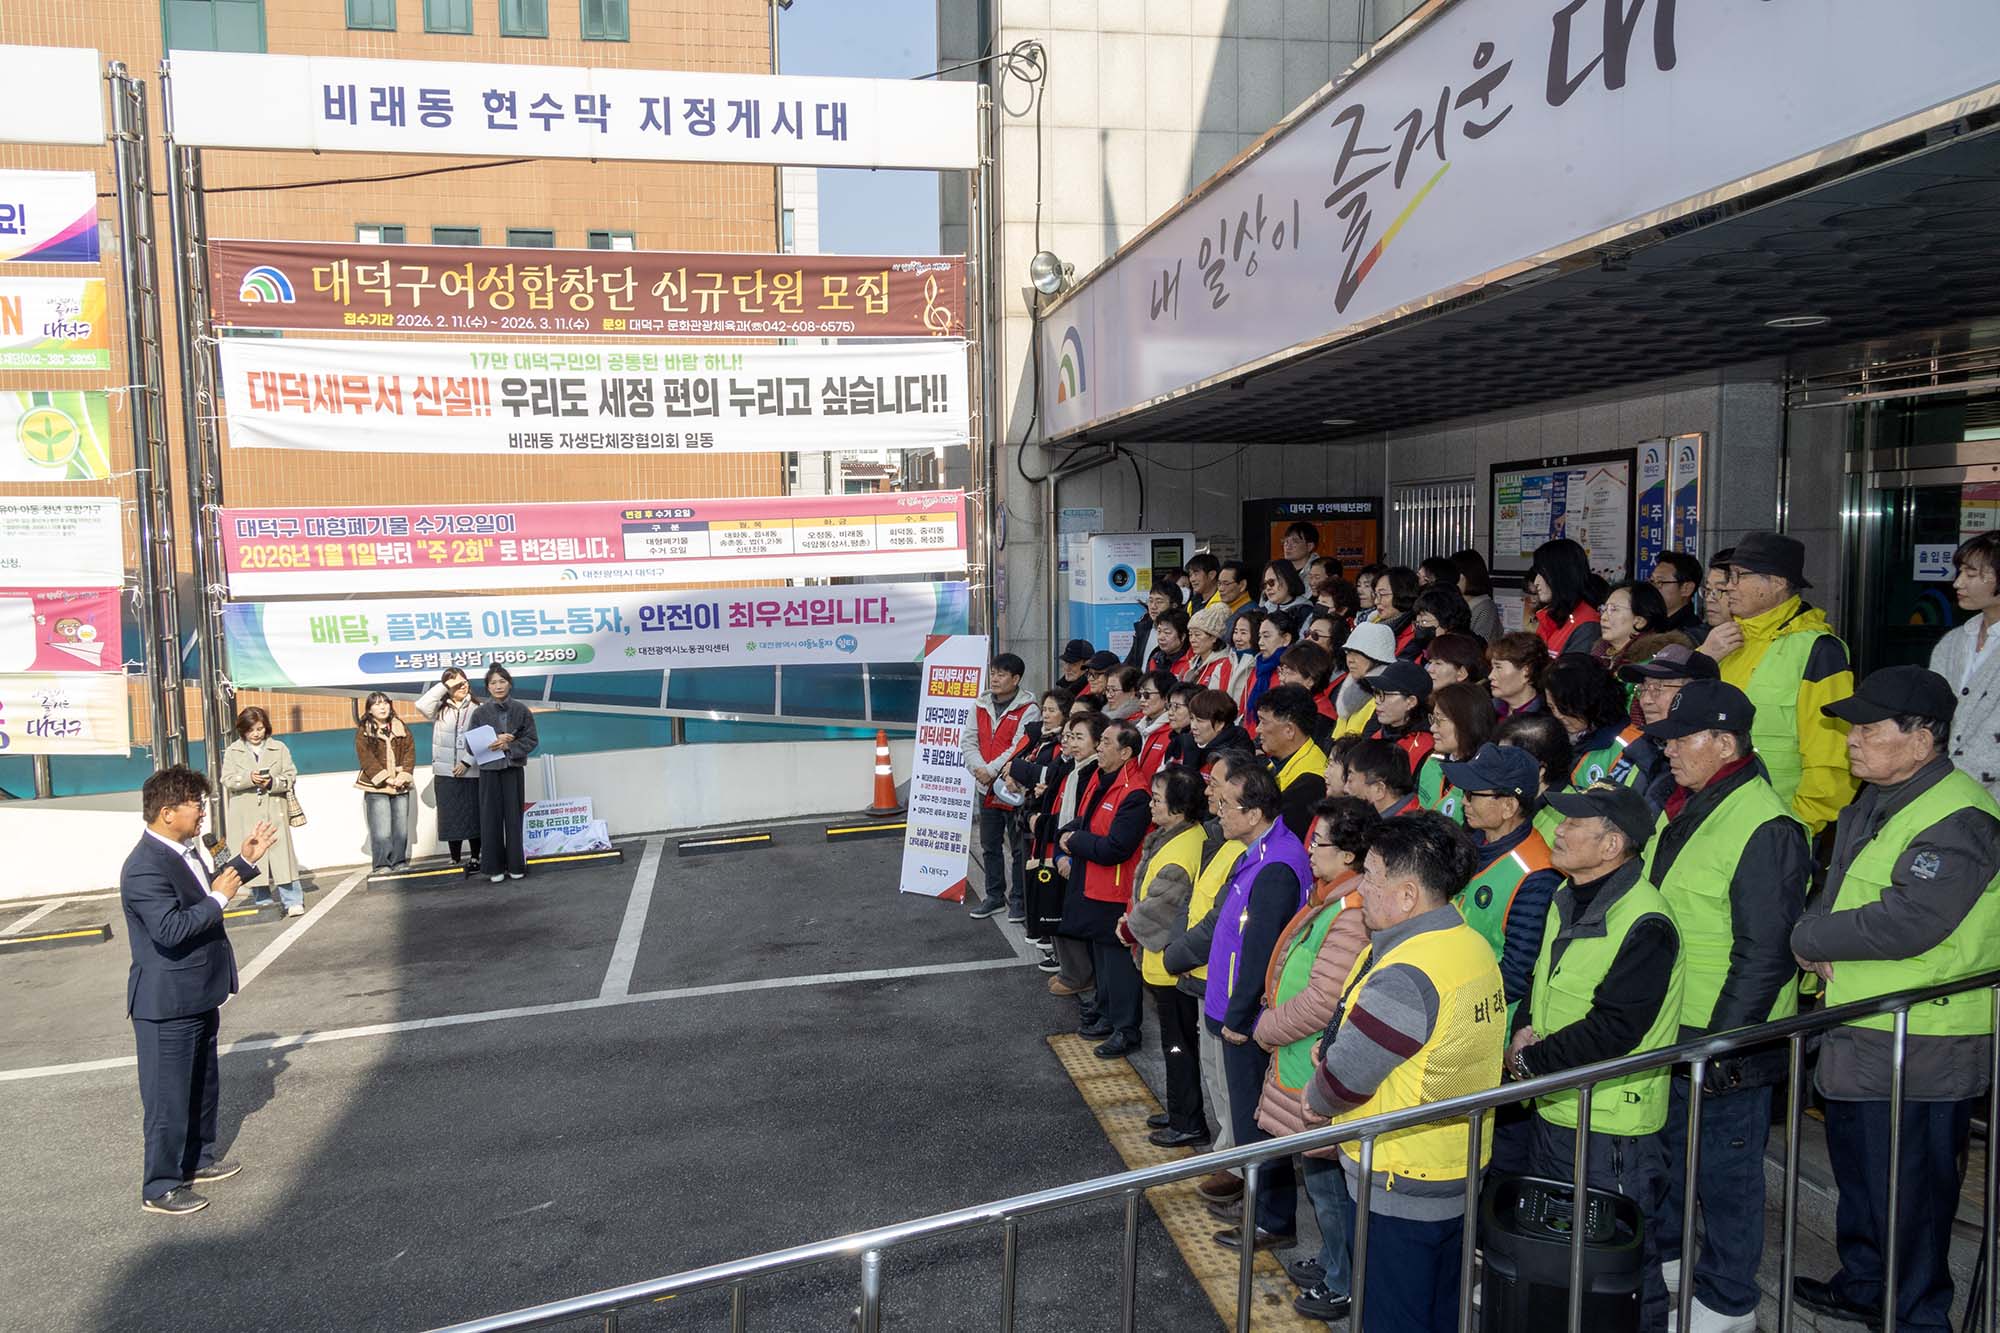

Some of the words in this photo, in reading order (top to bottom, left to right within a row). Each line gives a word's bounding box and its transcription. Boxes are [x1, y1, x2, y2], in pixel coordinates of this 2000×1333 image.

[322, 83, 455, 128] 비래동
[482, 87, 611, 133] 현수막
[638, 95, 849, 141] 지정게시대
[1151, 259, 1182, 322] 내
[1198, 192, 1300, 311] 일상이
[1325, 40, 1513, 314] 즐거운
[312, 258, 639, 312] 대덕구여성합창단
[651, 266, 804, 315] 신규단원
[817, 271, 890, 315] 모집
[343, 312, 393, 327] 접수기간
[396, 314, 434, 327] 2026.
[436, 315, 449, 328] 2.
[451, 314, 488, 330] 11.(수)
[501, 315, 537, 329] 2026.
[539, 317, 552, 330] 3.
[554, 316, 590, 331] 11.(수)
[602, 318, 626, 332] 문의
[629, 319, 665, 332] 대덕구
[469, 351, 509, 370] 17만
[513, 352, 602, 371] 대덕구민의
[607, 352, 659, 372] 공통된
[665, 353, 700, 372] 바람
[704, 353, 744, 371] 하나!
[247, 371, 403, 415] 대덕세무서
[412, 376, 492, 417] 신설!!
[501, 377, 589, 418] 우리도
[600, 376, 655, 418] 세정
[663, 376, 719, 418] 편의
[728, 375, 813, 418] 누리고
[821, 374, 948, 417] 싶습니다!!
[508, 432, 554, 449] 비래동
[558, 431, 680, 450] 자생단체장협의회
[684, 431, 714, 449] 일동
[625, 510, 642, 519] 변경
[655, 509, 672, 518] 수거
[674, 508, 691, 518] 요일
[235, 517, 301, 539] 대덕구
[304, 515, 410, 538] 대형폐기물
[414, 513, 515, 535] 수거요일이
[239, 544, 311, 568] 2026년
[315, 542, 345, 567] 1월
[347, 541, 414, 566] 1일부터
[416, 539, 448, 564] "주
[452, 537, 494, 563] 2회"
[499, 539, 518, 562] 로
[521, 536, 615, 561] 변경됩니다.
[649, 547, 667, 555] 수거
[670, 546, 687, 554] 요일
[309, 613, 380, 645] 배달,
[386, 610, 473, 642] 플랫폼
[481, 605, 632, 638] 이동노동자,
[638, 602, 720, 632] 안전이
[728, 596, 896, 629] 최우선입니다.
[394, 651, 484, 669] 노동법률상담
[486, 646, 577, 665] 1566-2569
[638, 643, 730, 656] 대전광역시노동권익센터
[932, 668, 964, 682] 대덕세무서
[965, 669, 979, 683] 신설
[930, 681, 944, 695] 주민
[946, 682, 960, 696] 서명
[962, 682, 977, 697] 운동
[27, 714, 82, 738] 대덕구
[925, 706, 957, 725] 대덕구민의
[919, 725, 960, 748] 대덕세무서
[922, 748, 930, 764] 꼭
